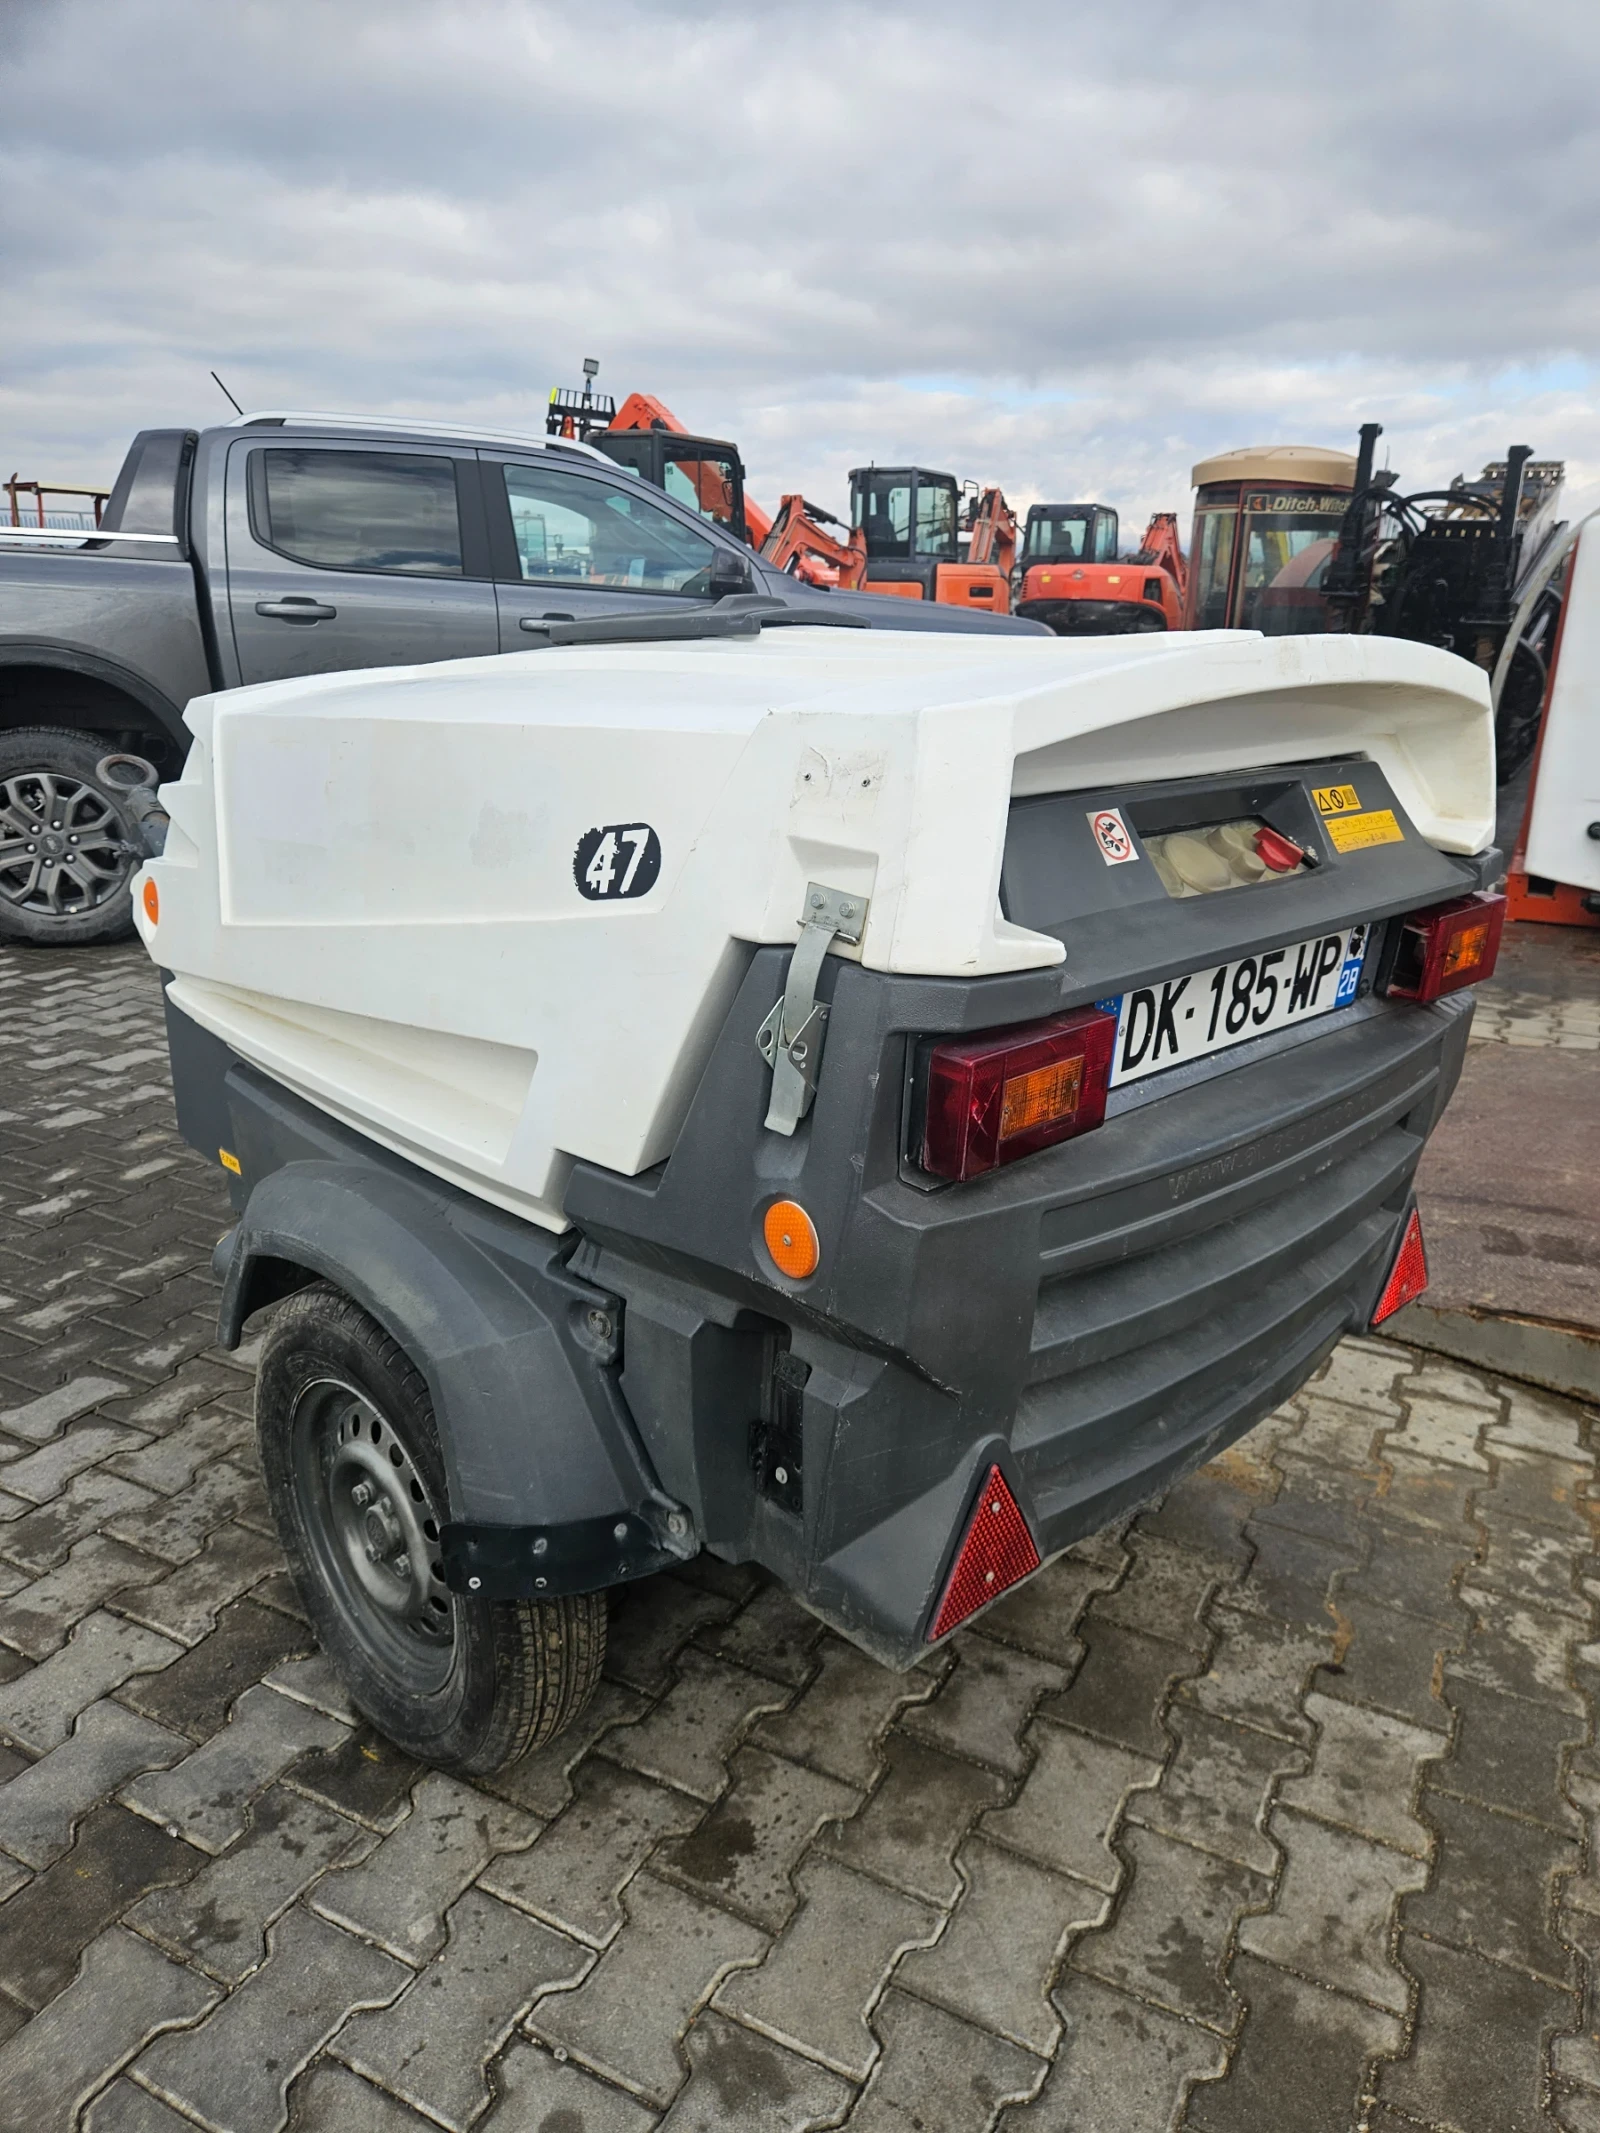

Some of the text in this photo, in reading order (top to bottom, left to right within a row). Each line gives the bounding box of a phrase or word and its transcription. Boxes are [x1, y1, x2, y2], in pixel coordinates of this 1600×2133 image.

[1273, 496, 1317, 511] Ditch
[585, 828, 650, 894] 47
[1120, 935, 1343, 1073] DK-185-WP
[1337, 966, 1360, 998] 28
